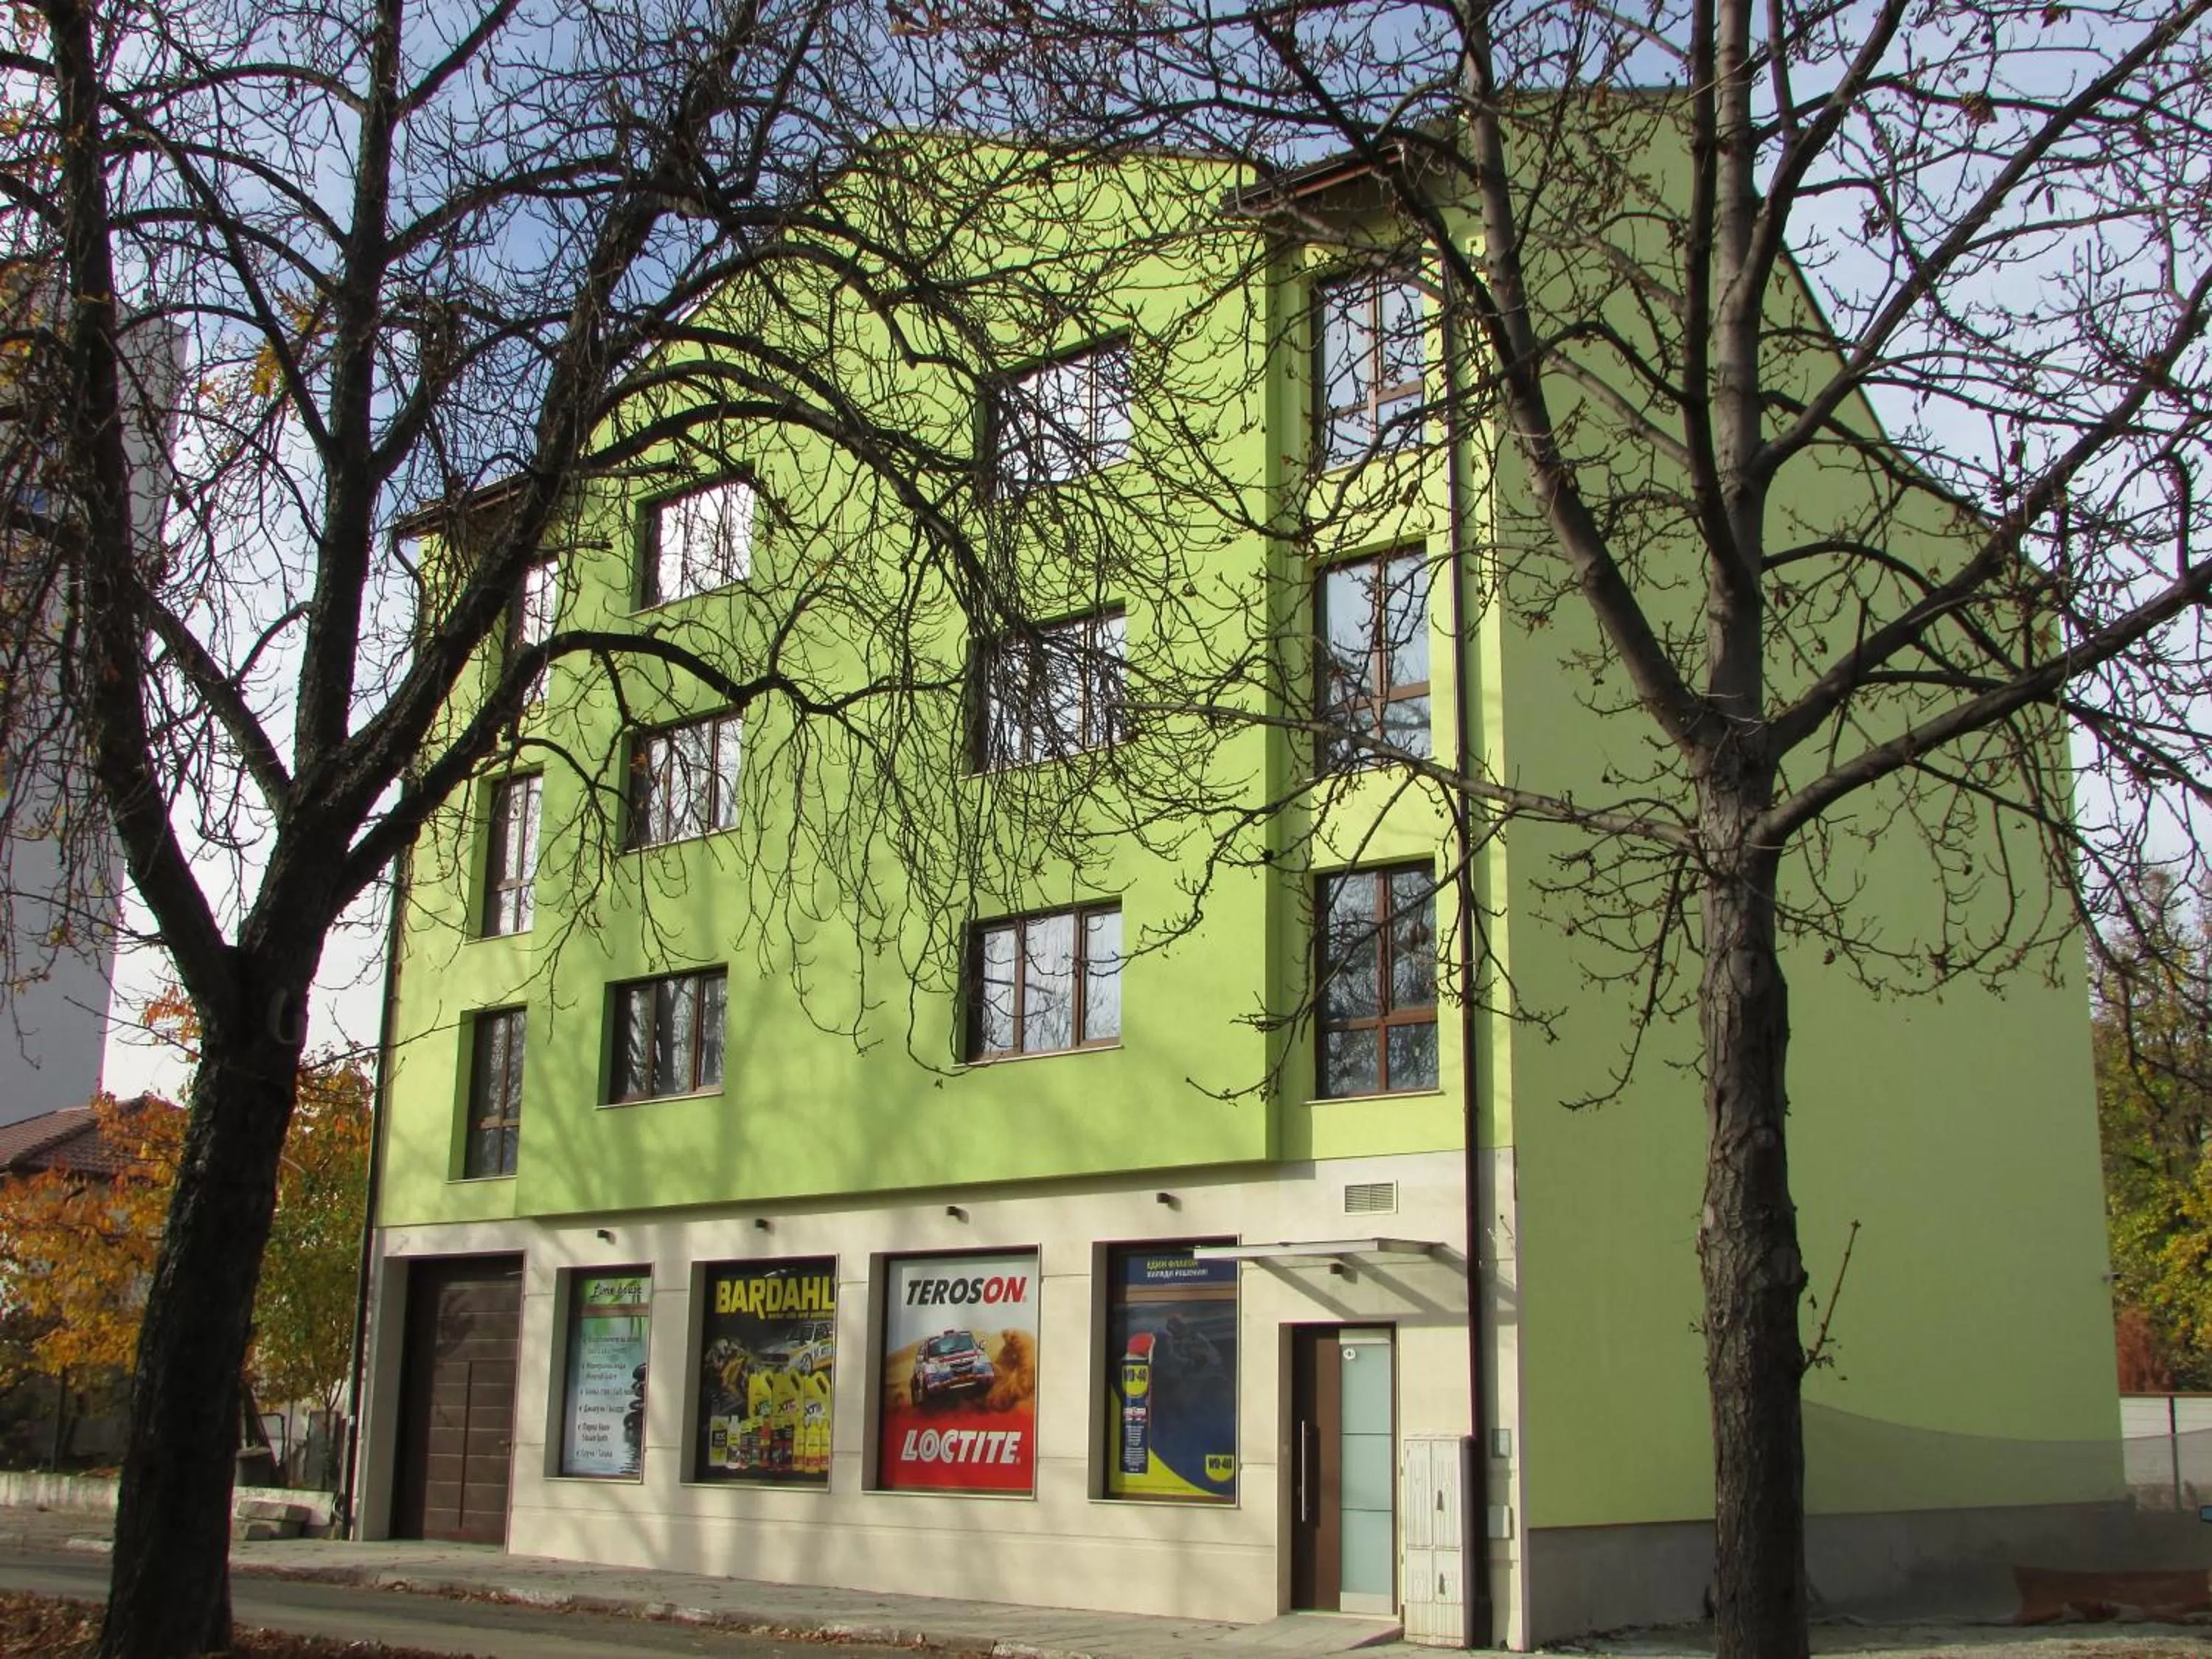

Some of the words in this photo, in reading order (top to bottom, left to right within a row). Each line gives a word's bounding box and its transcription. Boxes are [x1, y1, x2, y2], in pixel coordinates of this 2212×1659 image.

[715, 1276, 835, 1320] BARDAHL
[906, 1276, 1027, 1305] TEROSON
[901, 1429, 1022, 1464] LOCTITE
[1208, 1457, 1232, 1470] WD-40
